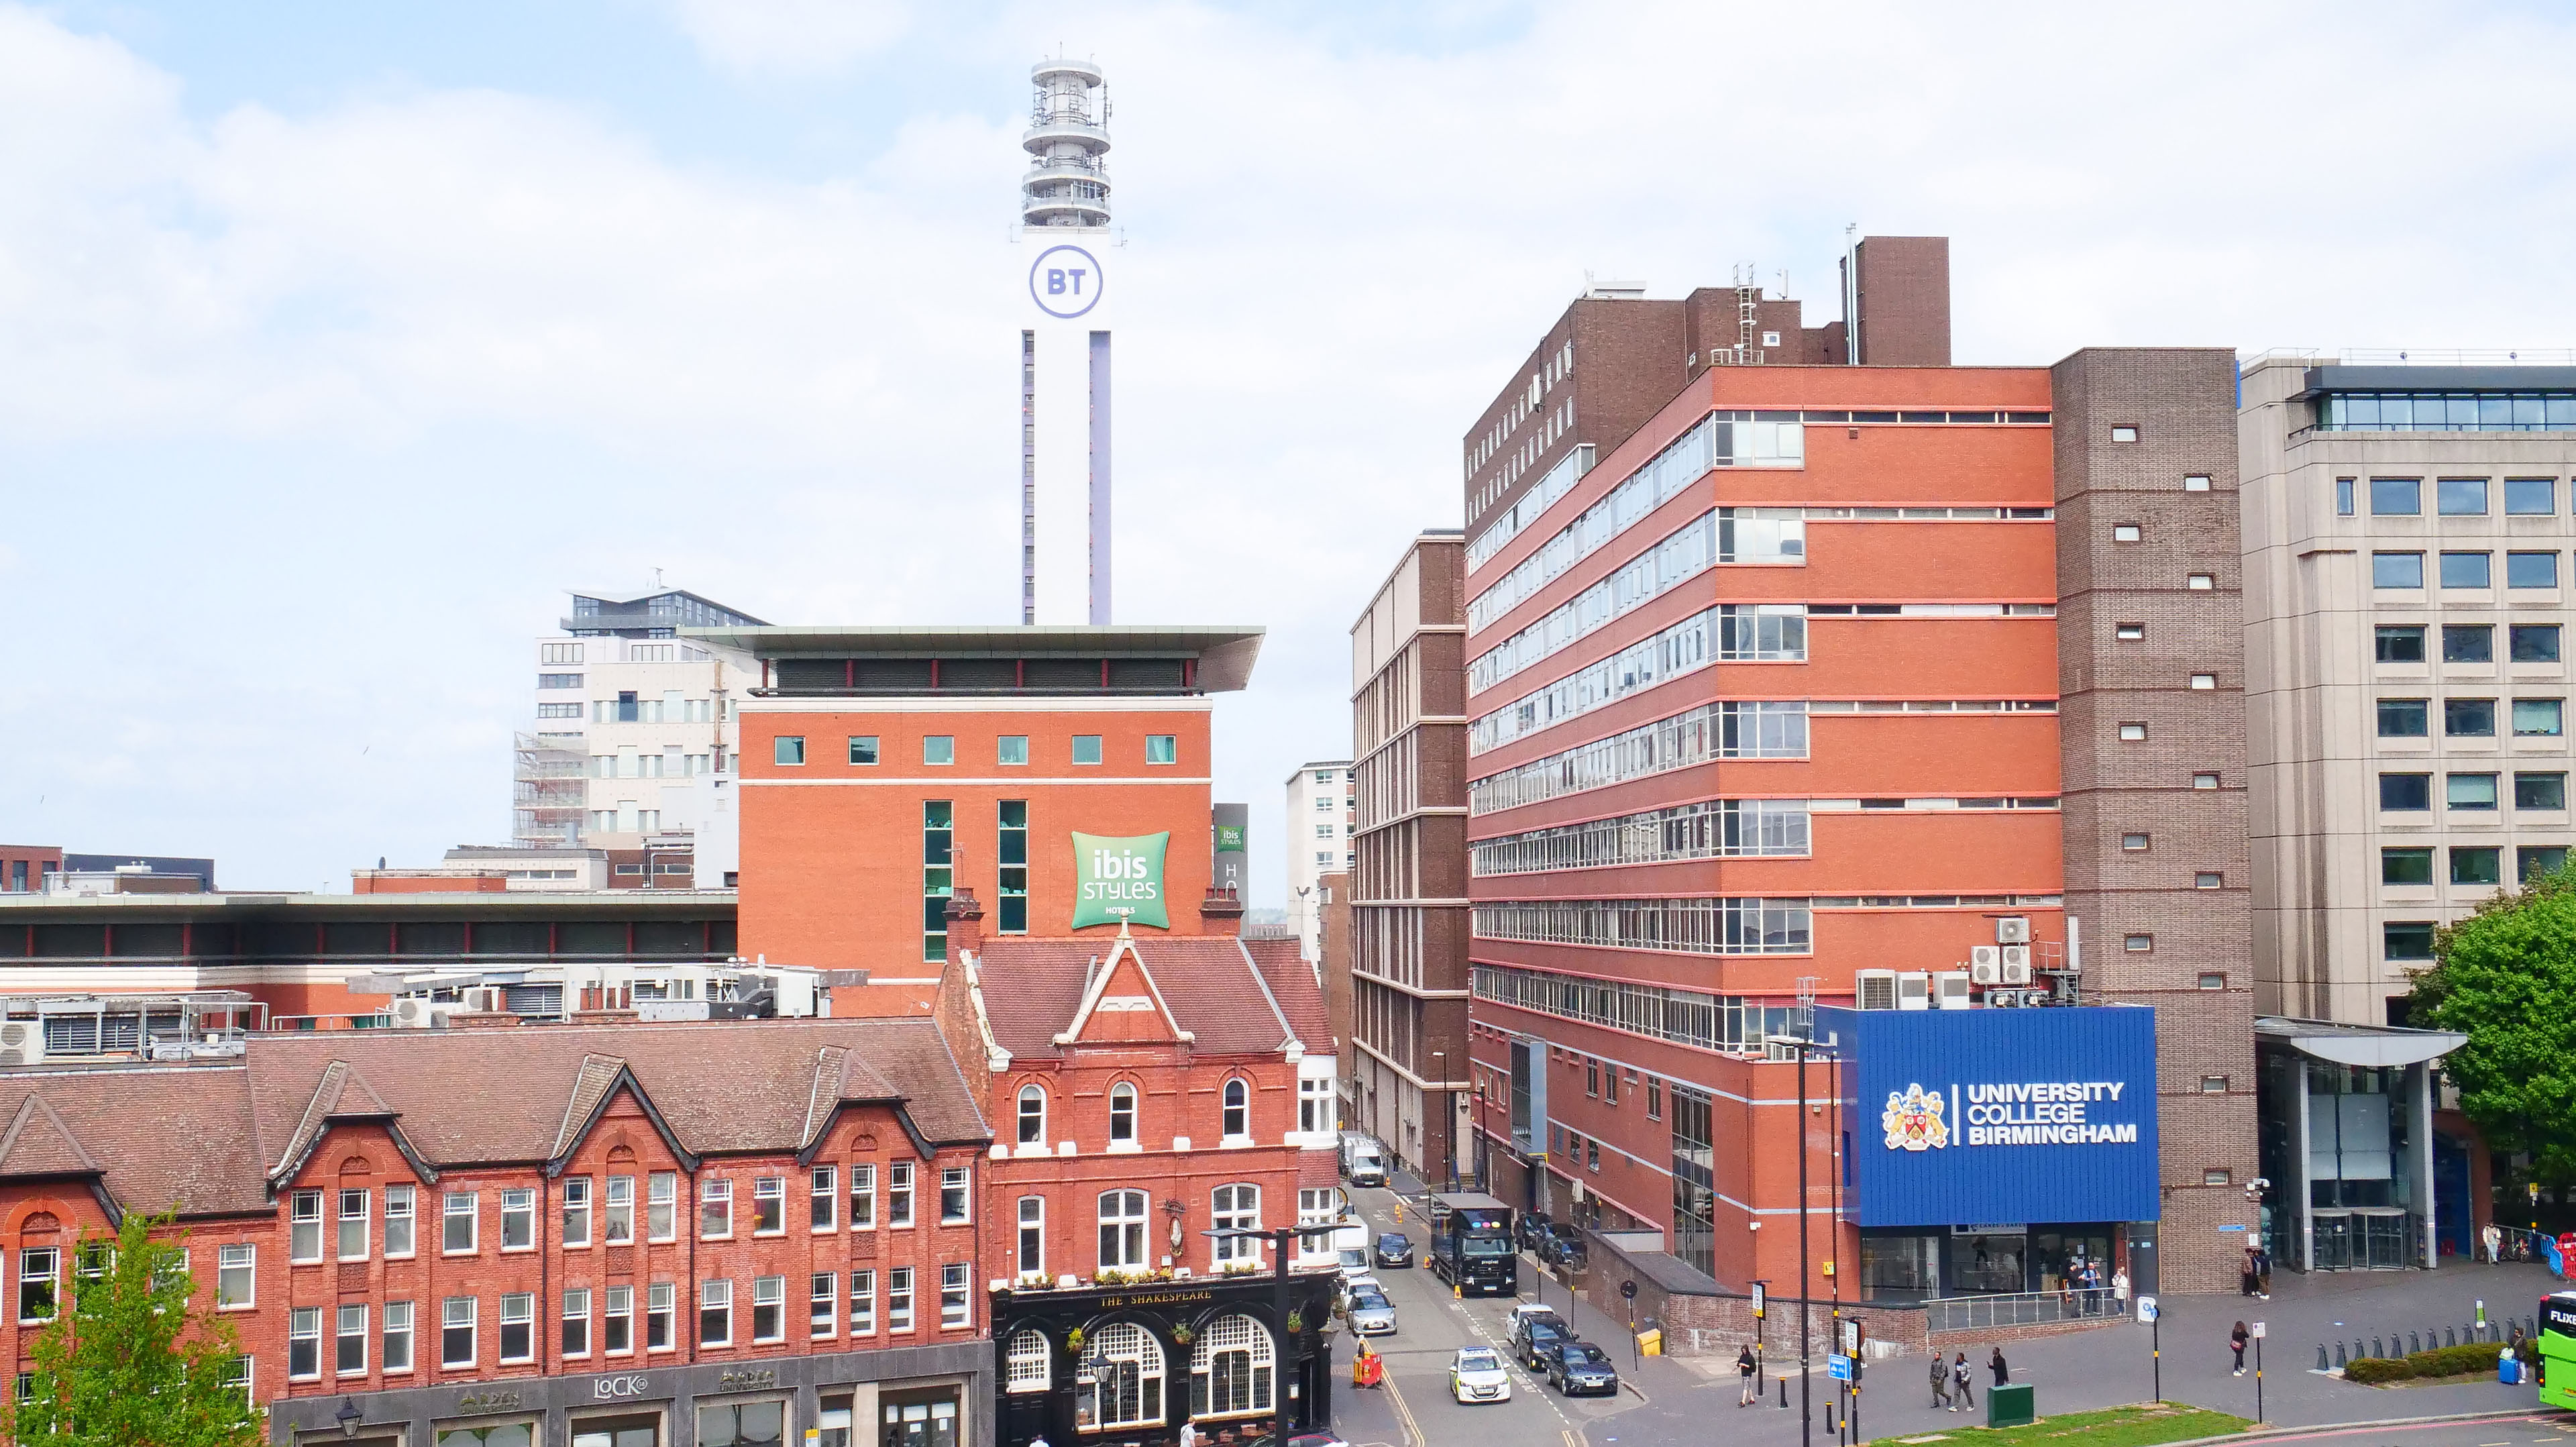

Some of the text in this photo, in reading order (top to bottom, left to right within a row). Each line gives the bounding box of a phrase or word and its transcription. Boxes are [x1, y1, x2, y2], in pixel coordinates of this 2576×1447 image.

[1048, 268, 1086, 295] BT
[1224, 828, 1238, 839] ibis
[1093, 849, 1148, 879] ibis
[1968, 1082, 2125, 1103] UNIVERSITY
[1967, 1103, 2086, 1125] COLLEGE
[1968, 1124, 2137, 1146] BIRMINGHAM
[1101, 1289, 1212, 1307] THE SHAKESPEARE
[593, 1375, 641, 1399] LOCK
